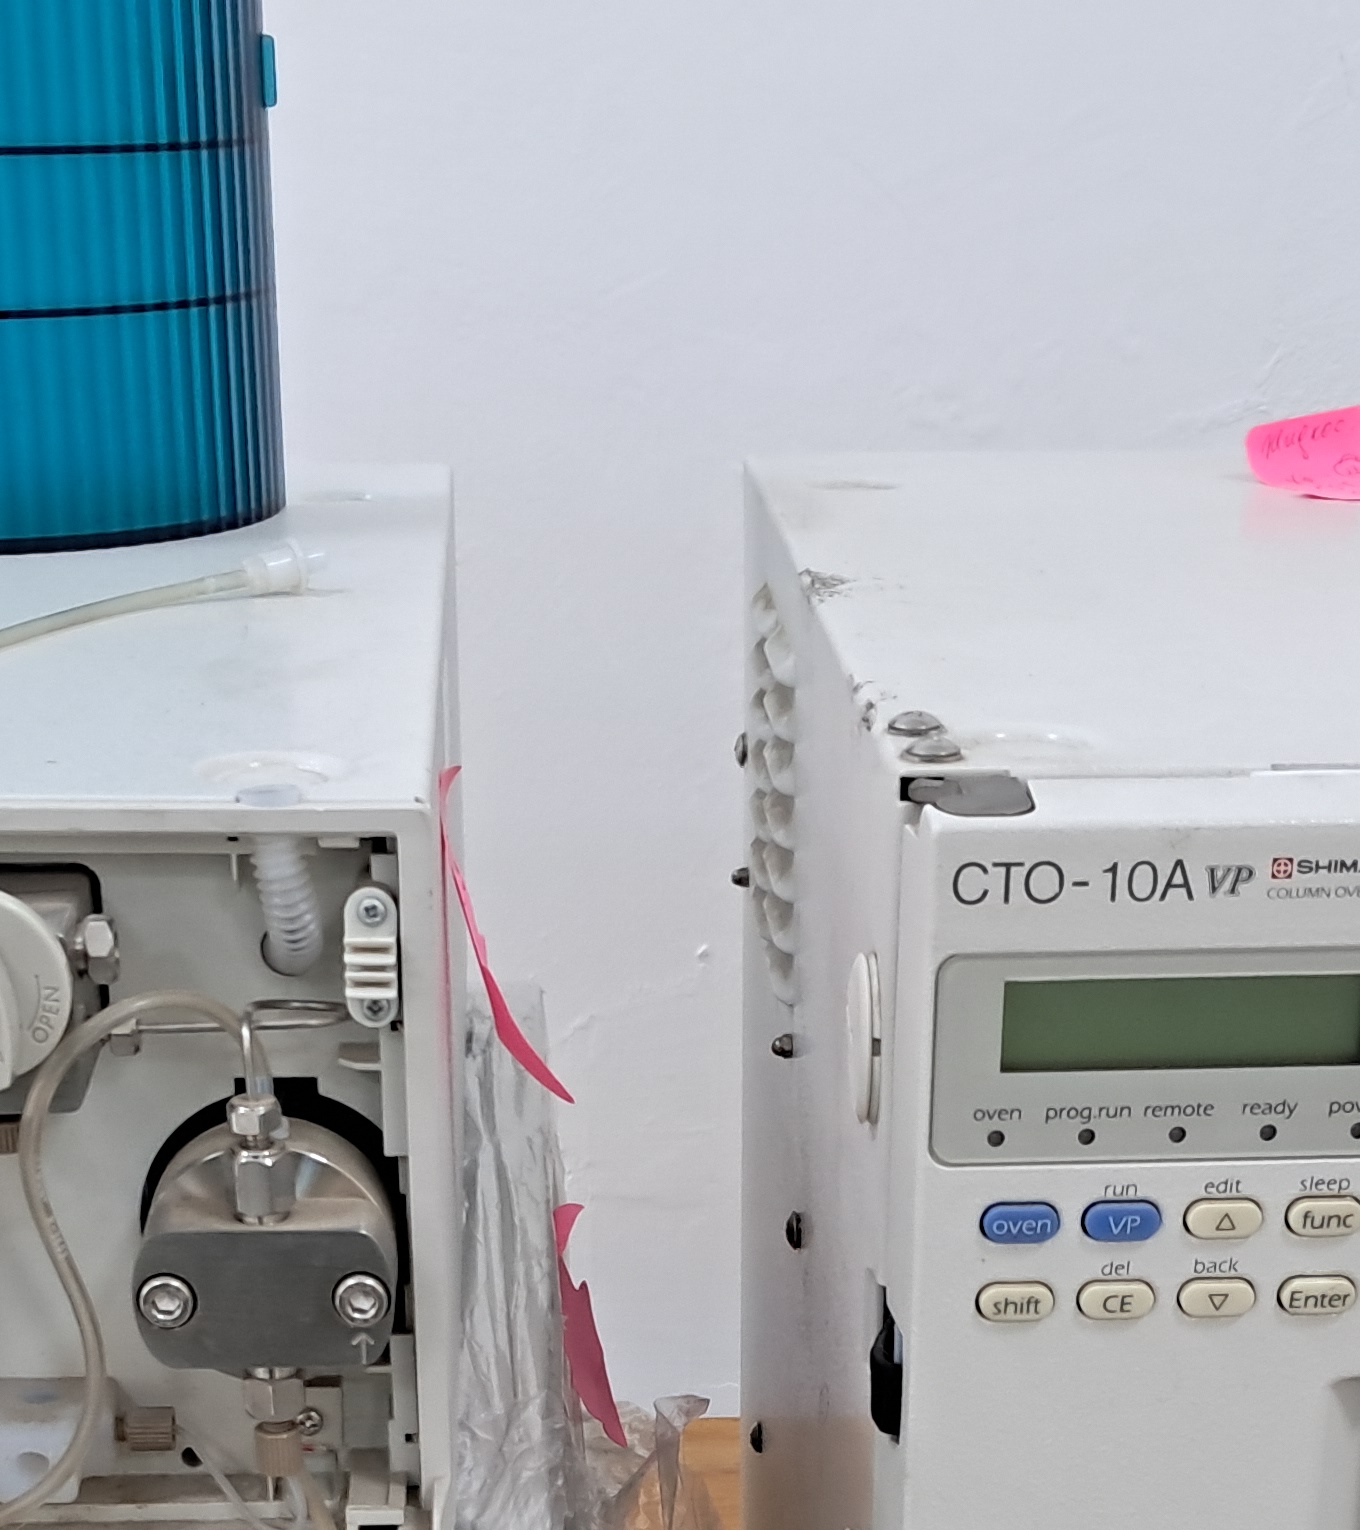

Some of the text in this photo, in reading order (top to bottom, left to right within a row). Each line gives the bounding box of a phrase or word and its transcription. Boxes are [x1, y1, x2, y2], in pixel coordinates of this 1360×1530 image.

[952, 858, 1256, 906] CTO-10A VP
[1266, 885, 1332, 900] COLUMN
[31, 984, 61, 1044] OPEN
[973, 1106, 1023, 1122] oven
[1045, 1103, 1132, 1124] prog.run
[1144, 1100, 1215, 1119] remote
[1241, 1099, 1299, 1120] ready
[1103, 1175, 1351, 1197] run edit sleep
[992, 1209, 1354, 1237] oven VP func
[1100, 1257, 1239, 1278] del back
[992, 1289, 1350, 1316] shift CE Enter
